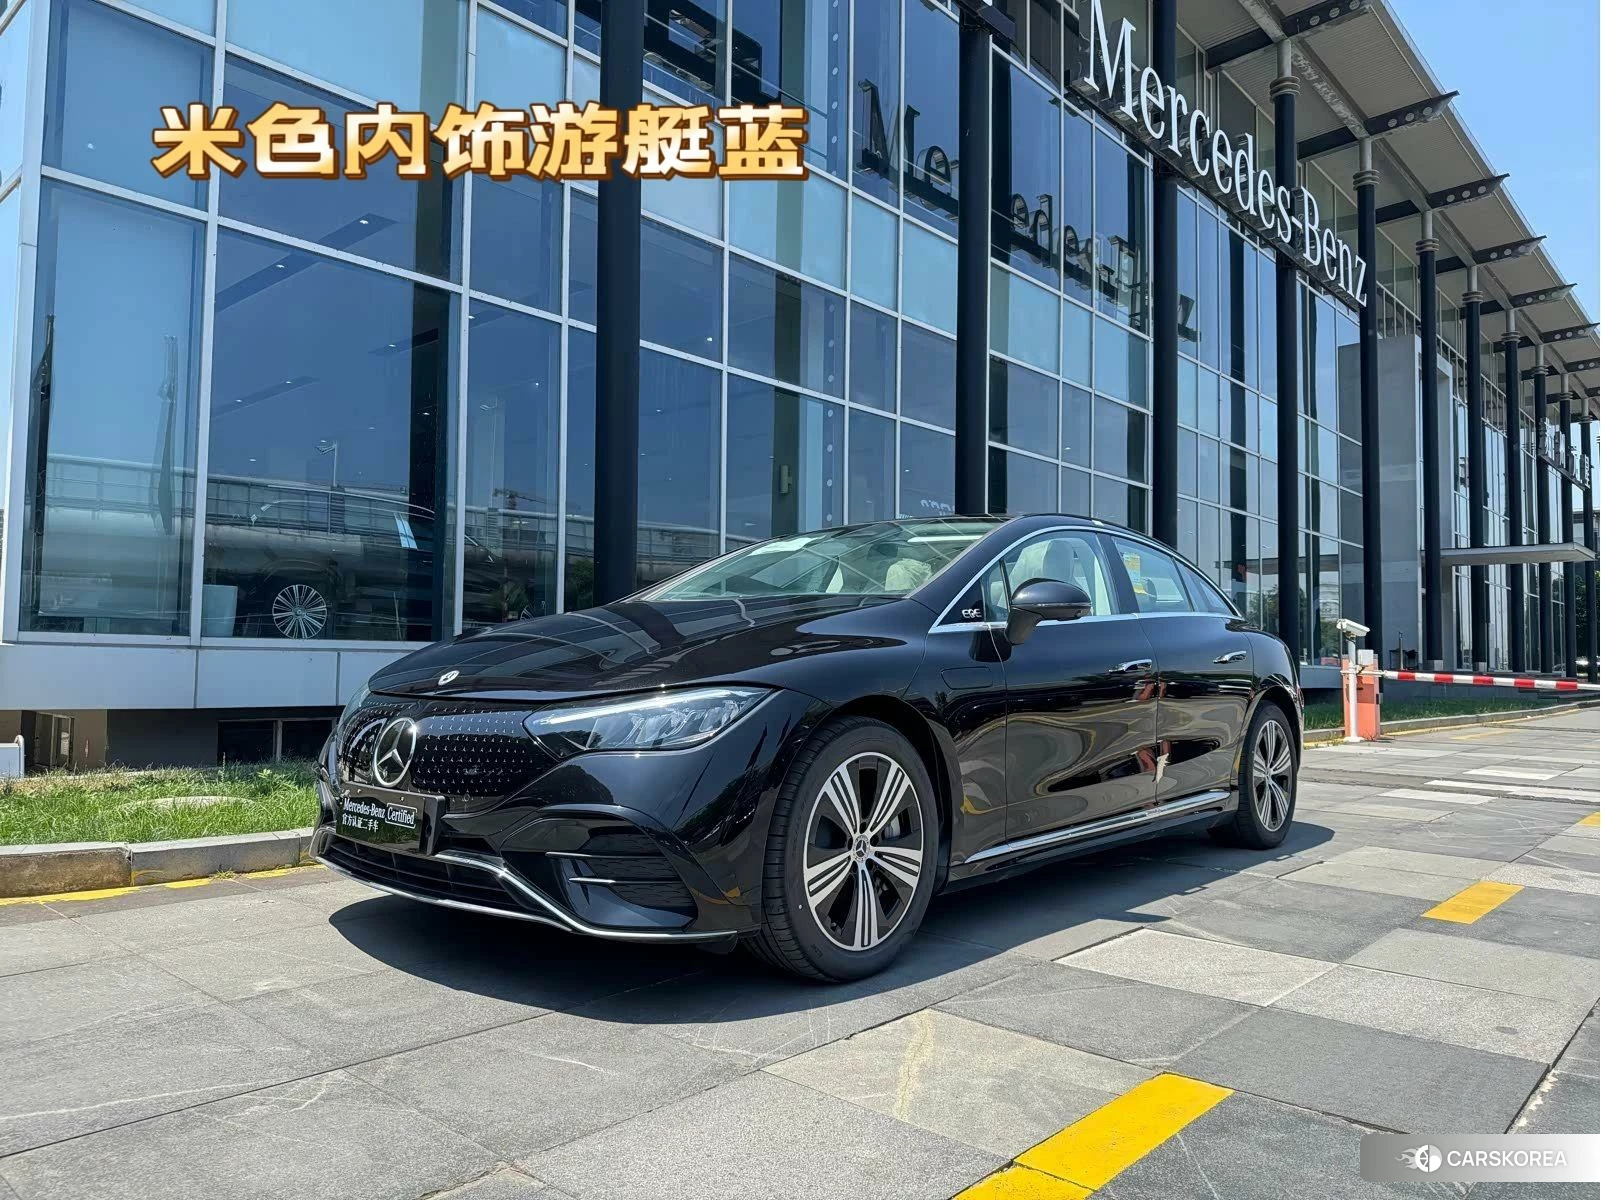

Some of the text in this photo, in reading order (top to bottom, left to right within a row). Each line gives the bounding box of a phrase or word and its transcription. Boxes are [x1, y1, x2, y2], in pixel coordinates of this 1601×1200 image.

[1083, 0, 1368, 308] Mercedes-Benz
[961, 608, 982, 619] EQE
[342, 812, 379, 832] 官方认证二手车
[343, 797, 415, 825] Mercedes-Benz Certified
